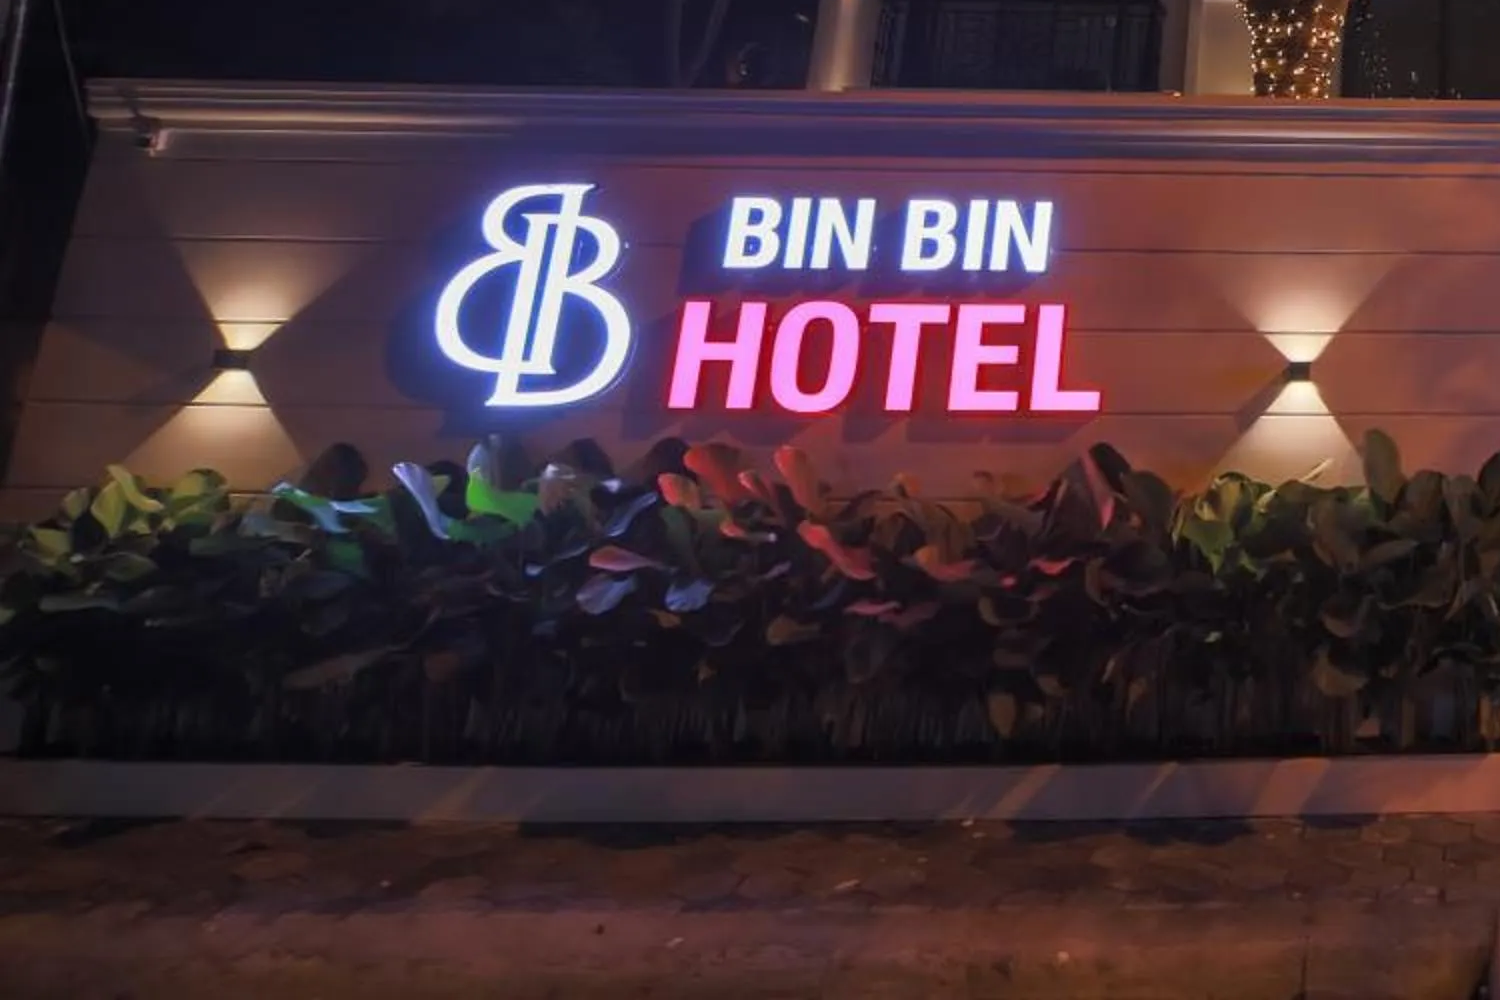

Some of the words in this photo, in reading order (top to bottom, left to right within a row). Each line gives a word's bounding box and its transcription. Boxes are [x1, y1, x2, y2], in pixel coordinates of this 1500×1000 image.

[722, 196, 876, 271] BIN
[901, 198, 1053, 274] BIN
[667, 300, 1101, 413] HOTEL
